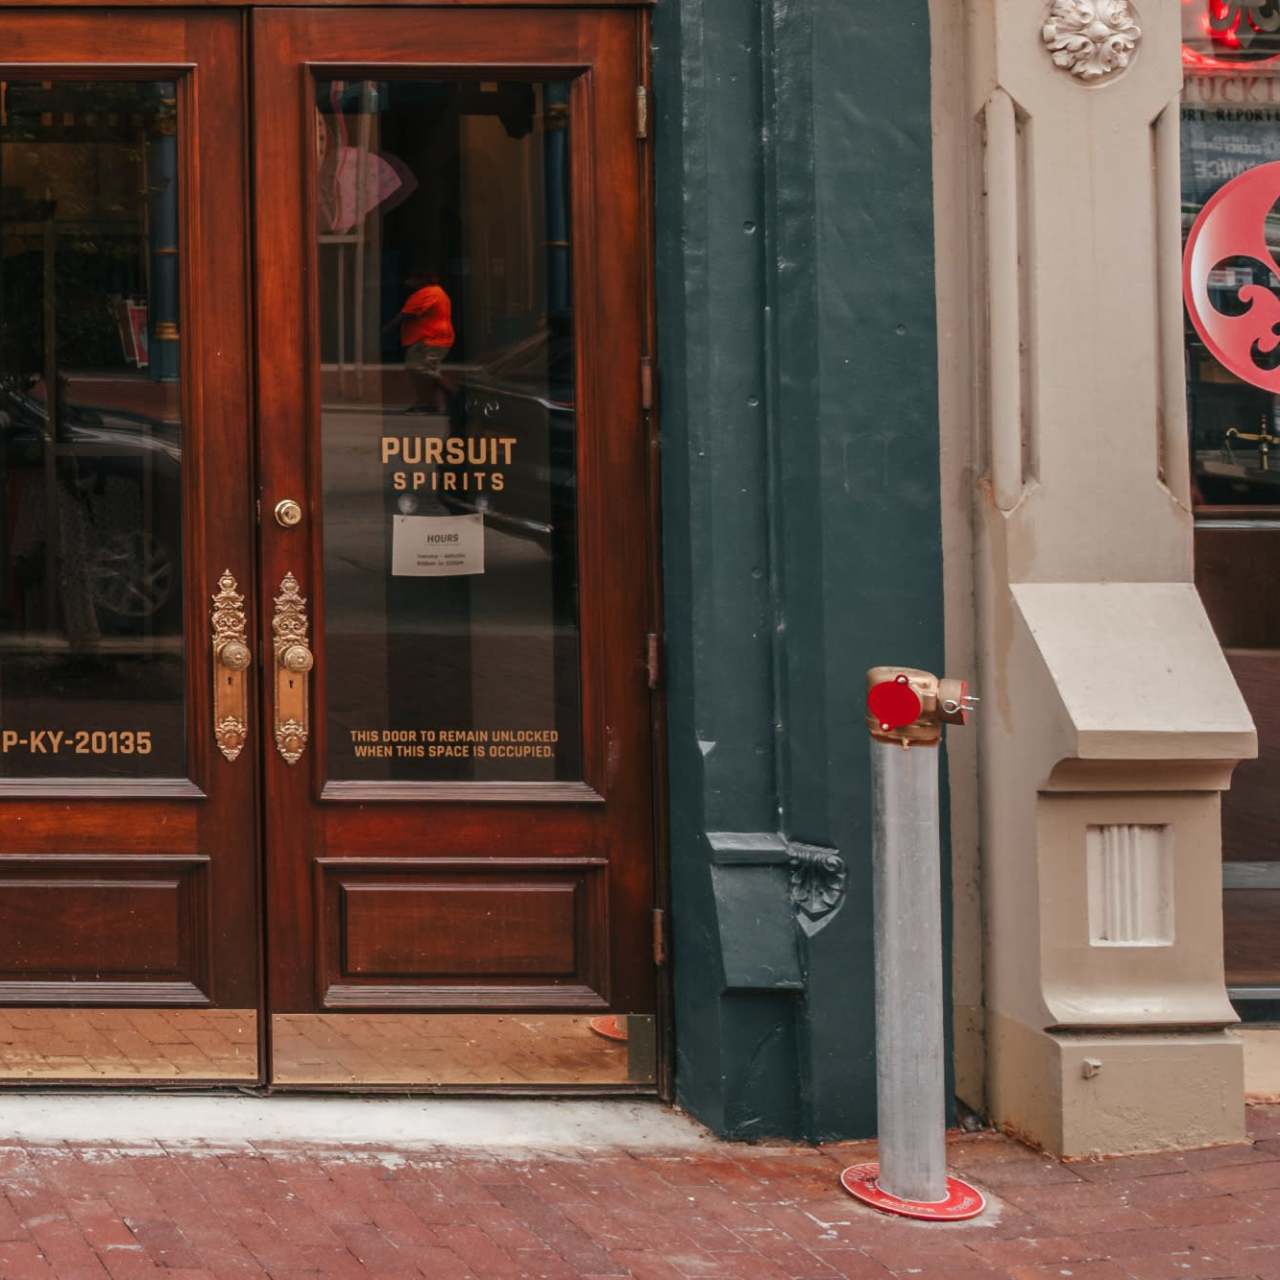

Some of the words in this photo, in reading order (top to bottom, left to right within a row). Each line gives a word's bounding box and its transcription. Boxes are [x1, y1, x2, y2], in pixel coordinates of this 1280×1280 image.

[381, 436, 517, 465] PURSUIT
[393, 471, 505, 491] SPIRITS
[427, 533, 459, 544] HOURS
[350, 730, 378, 742] THIS
[383, 730, 417, 742] DOOR
[420, 730, 436, 742] TO
[439, 730, 488, 742] REMAIN
[492, 730, 559, 742] UNLOCKED
[354, 745, 393, 757] WHEN
[397, 745, 425, 757] THIS
[428, 745, 470, 757] SPACE
[473, 745, 486, 757] IS
[489, 745, 555, 757] OCCUPIED.
